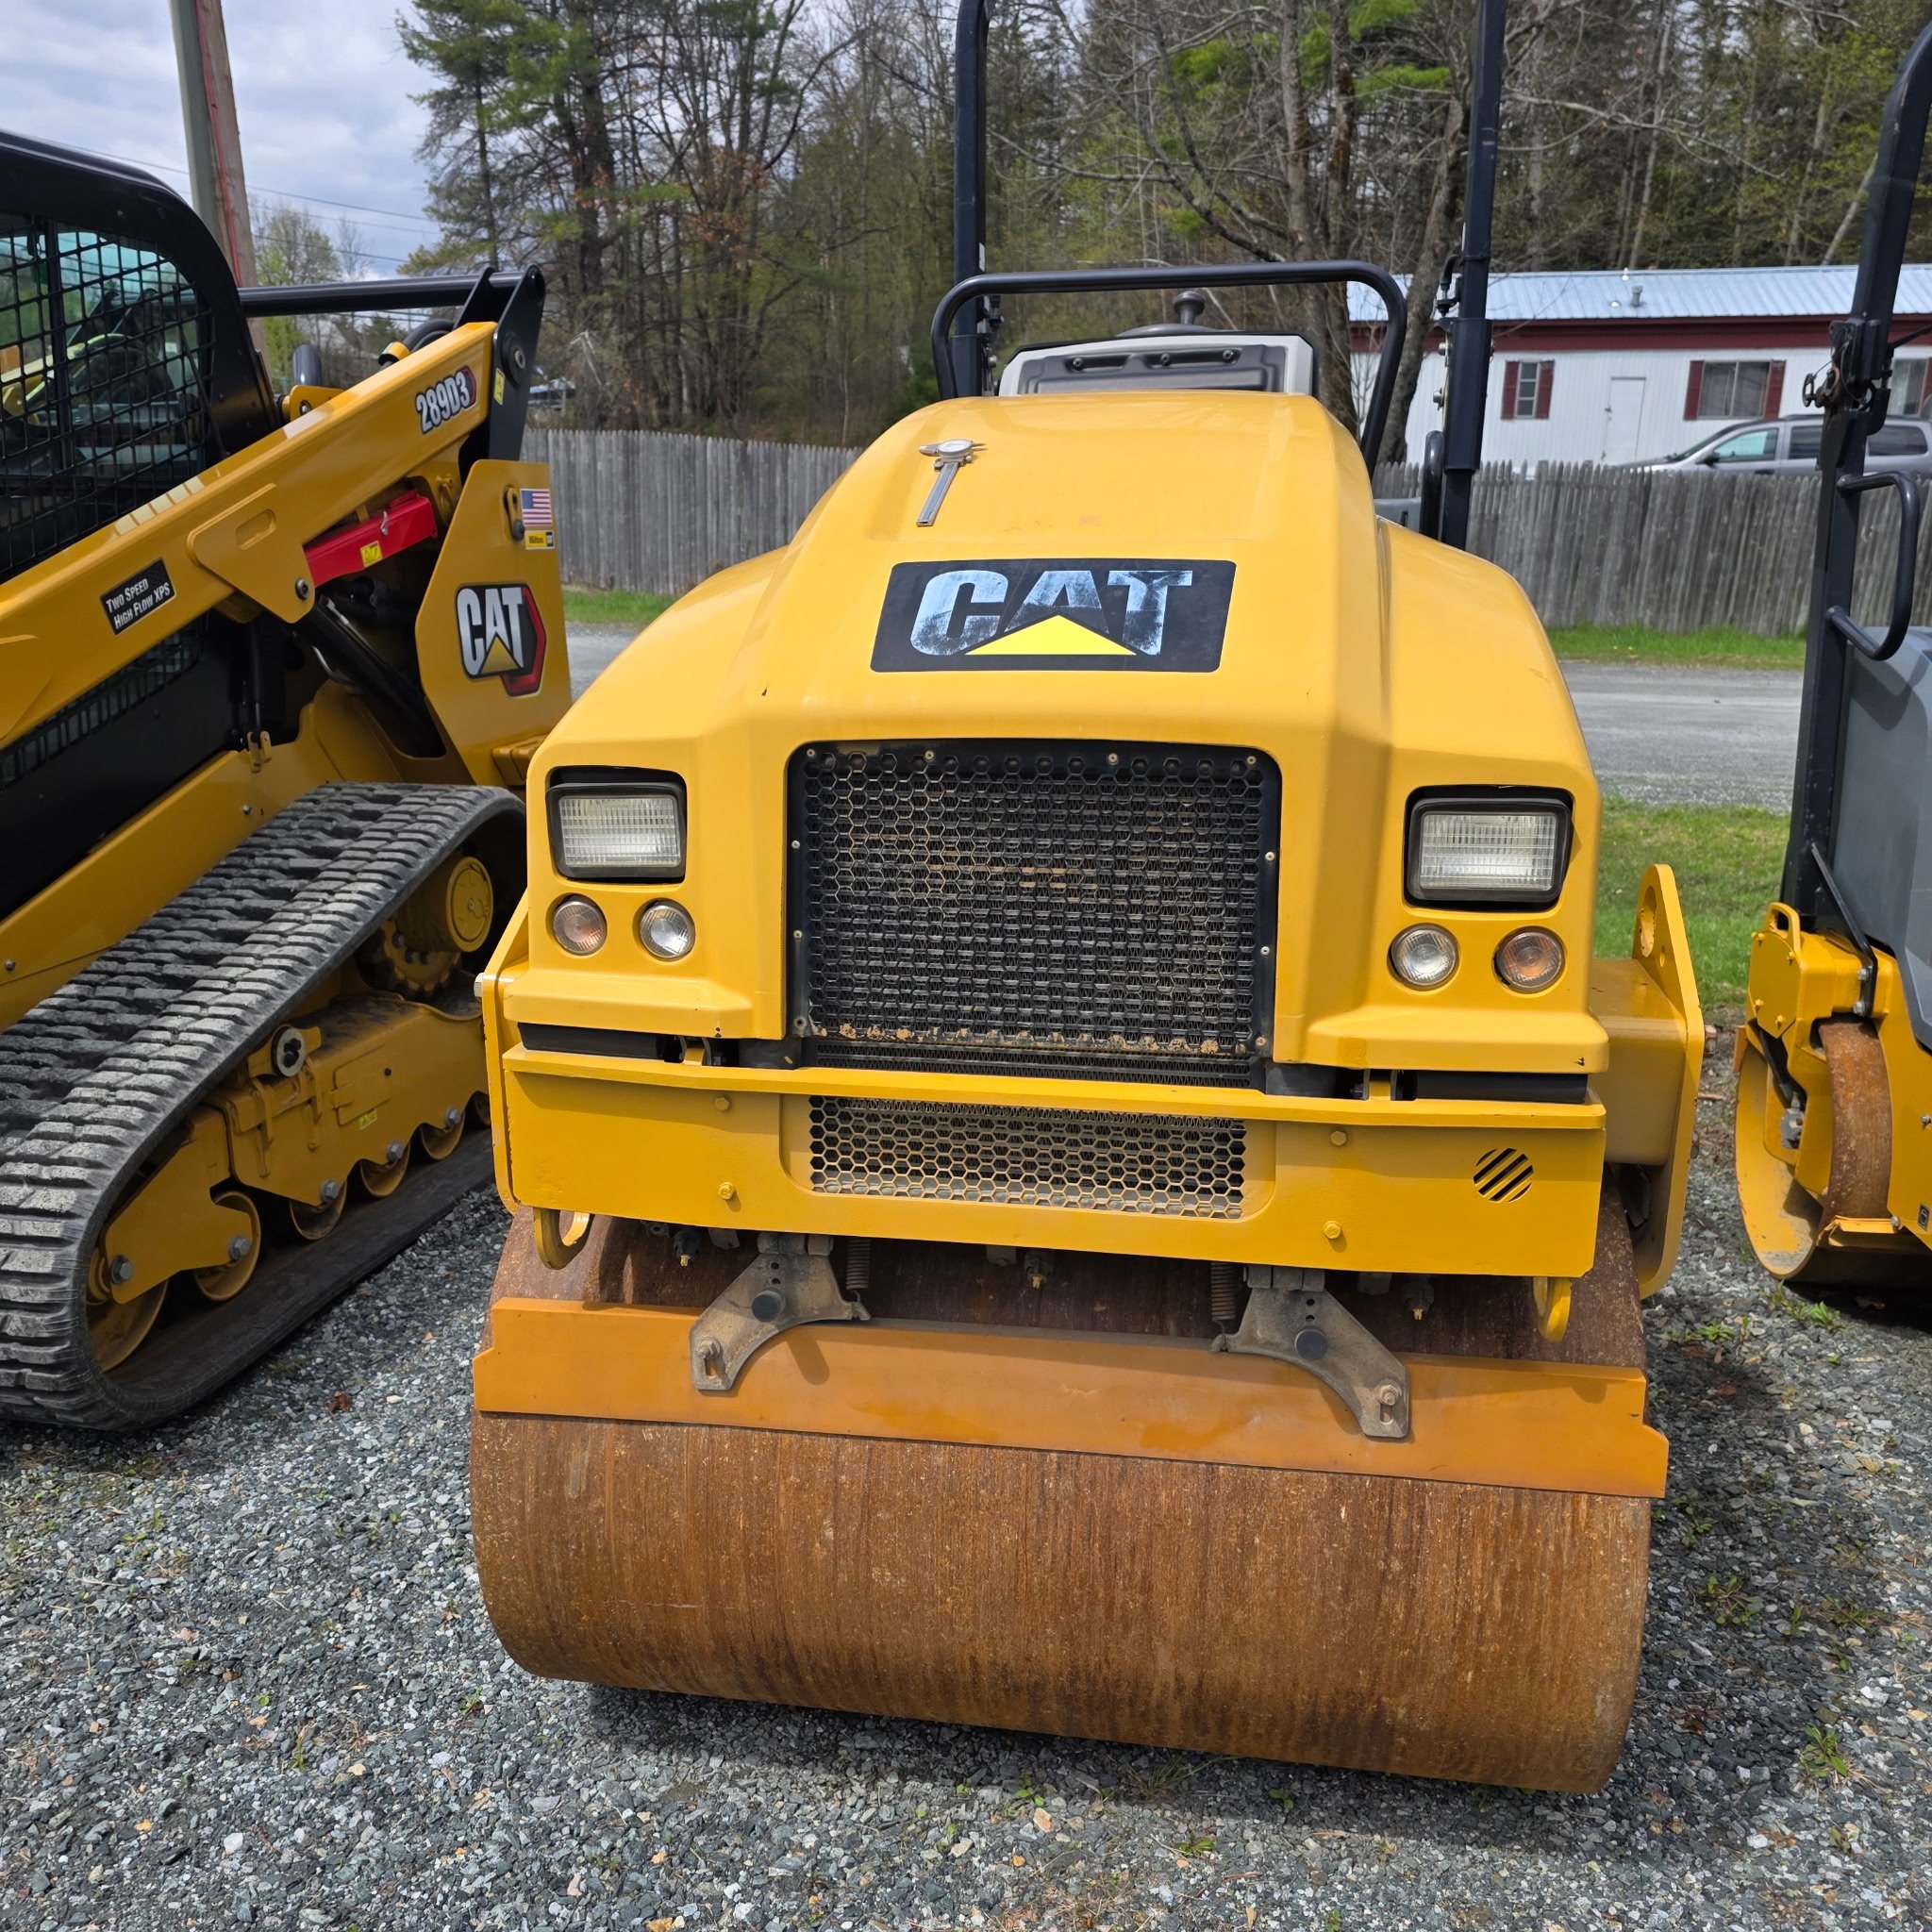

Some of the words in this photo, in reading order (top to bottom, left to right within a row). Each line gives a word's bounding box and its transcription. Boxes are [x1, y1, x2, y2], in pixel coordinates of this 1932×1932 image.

[415, 370, 471, 434] 289D3
[153, 581, 171, 603] XPS
[910, 569, 1193, 656] CAT
[457, 587, 525, 675] CAT
